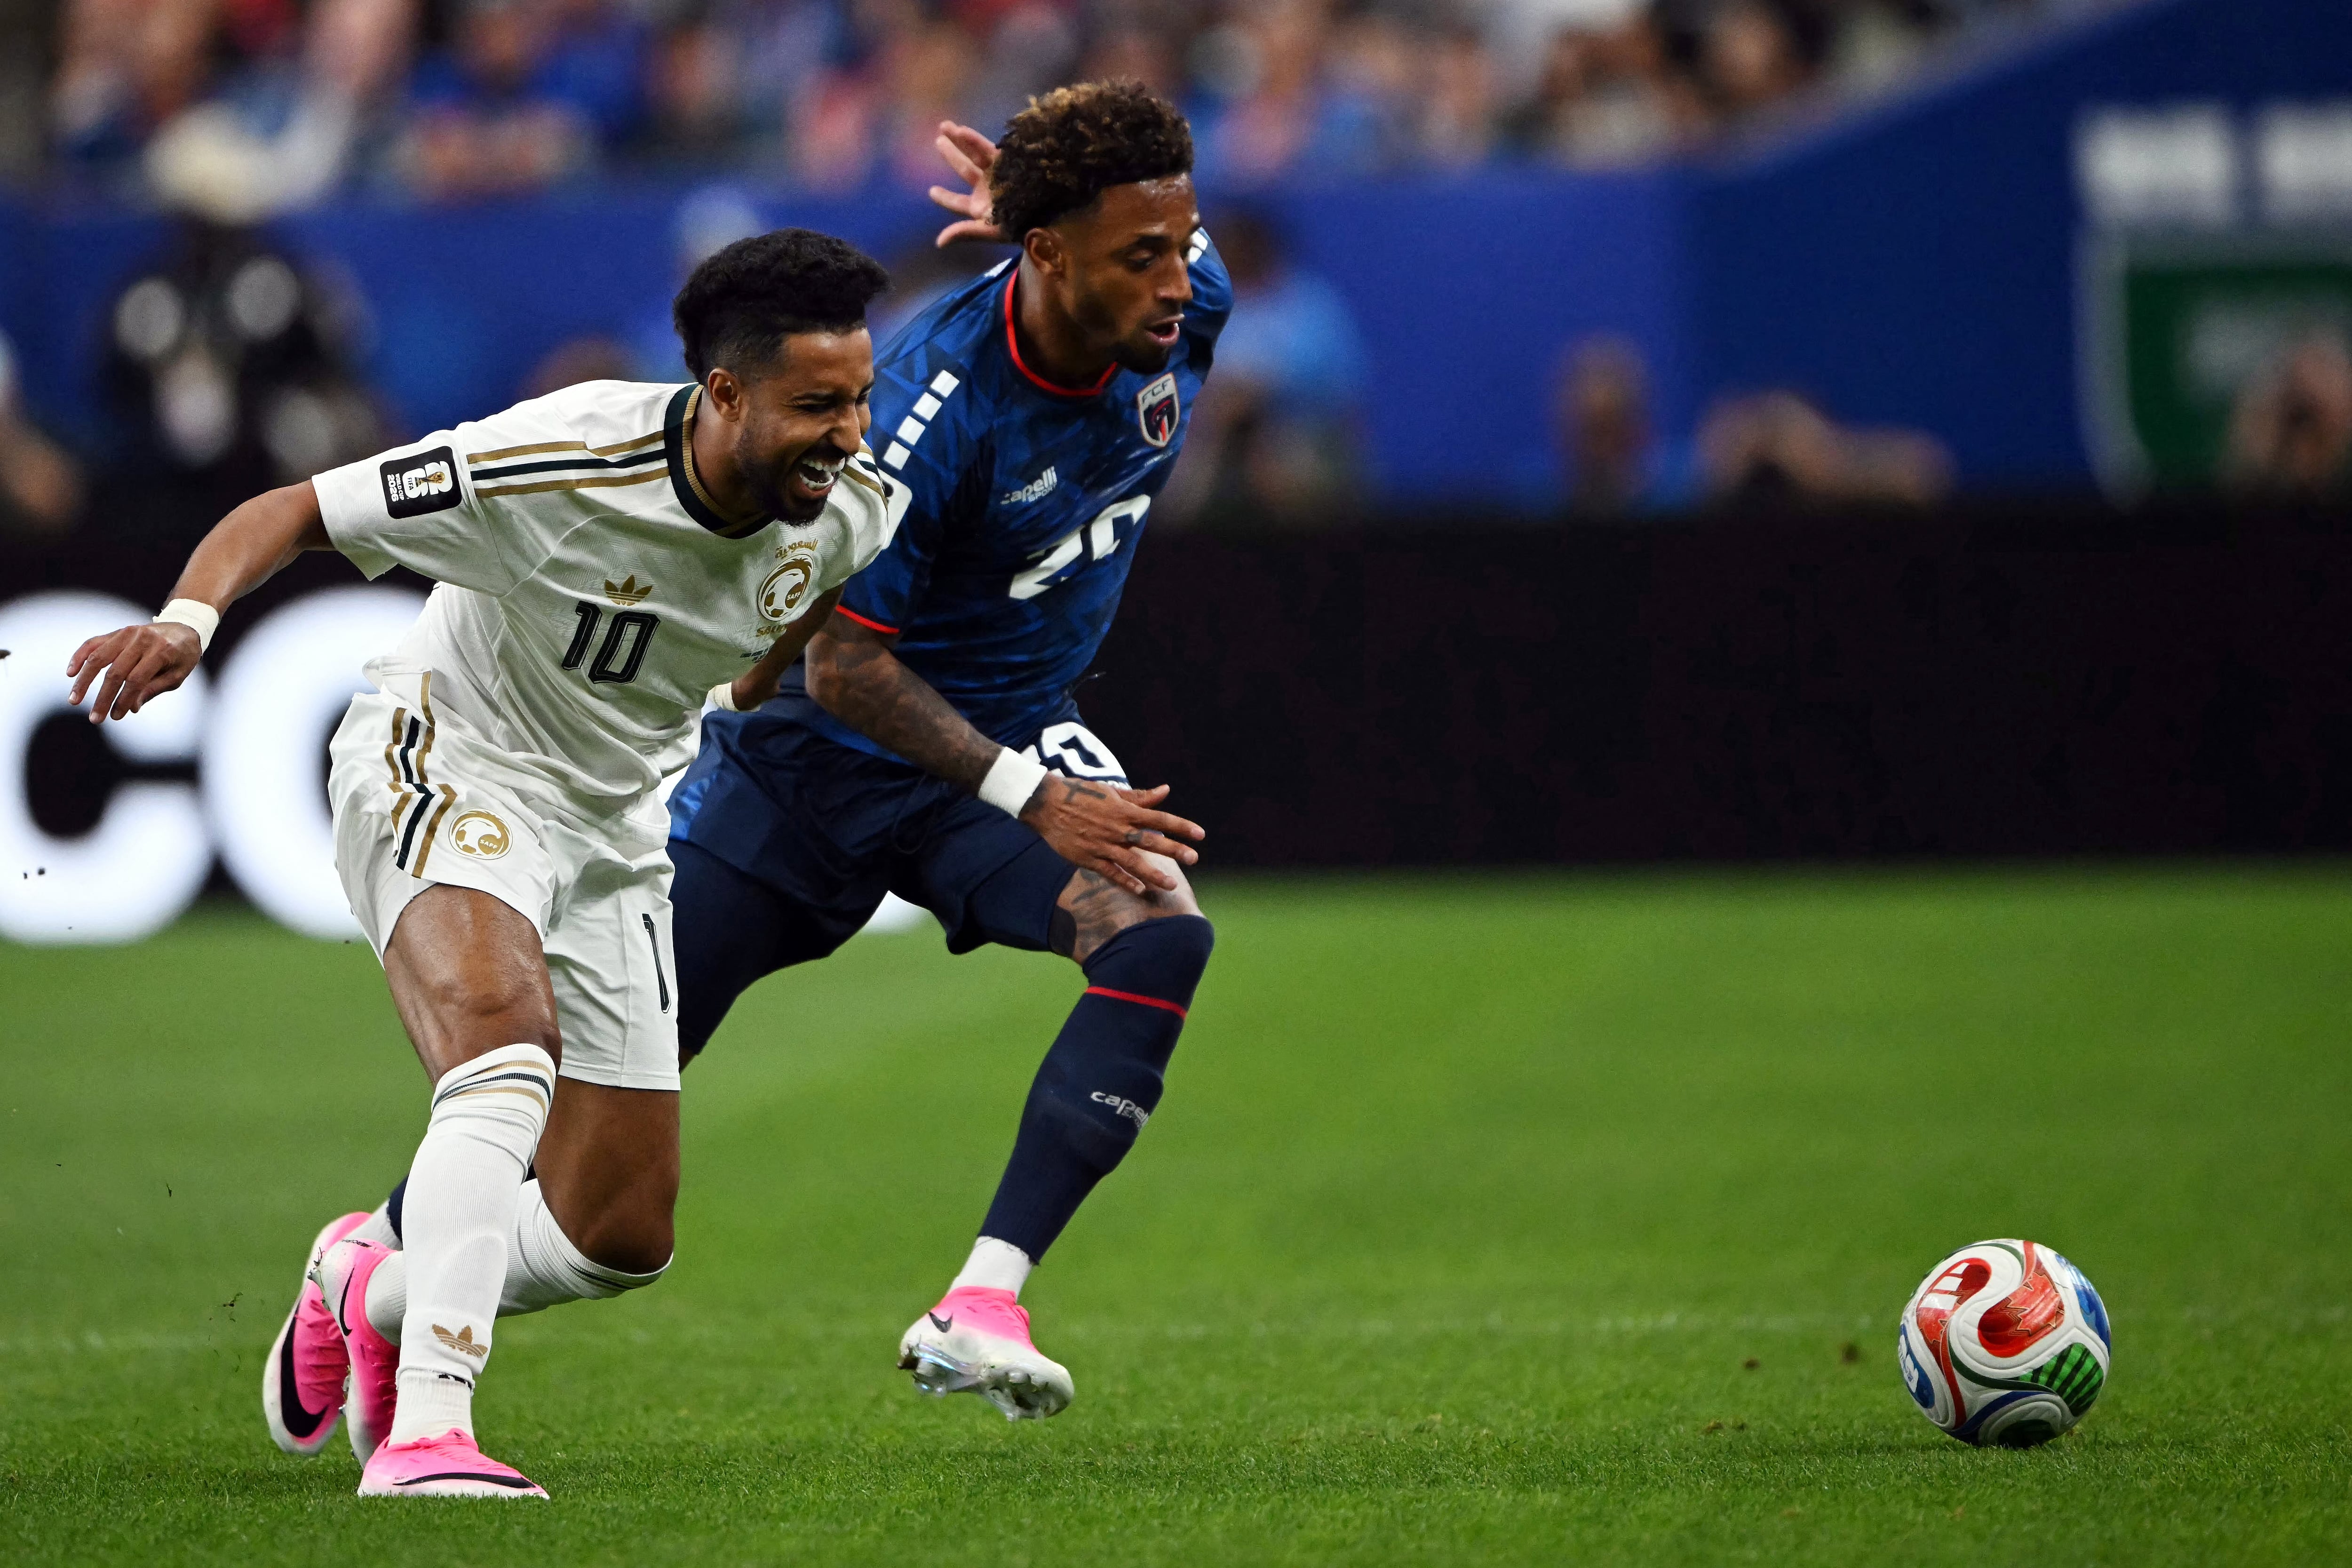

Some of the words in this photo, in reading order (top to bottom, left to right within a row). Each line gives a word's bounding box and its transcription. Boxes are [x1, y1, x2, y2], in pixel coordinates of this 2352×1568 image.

[1142, 378, 1171, 404] FCF
[387, 474, 399, 502] 2026
[787, 591, 801, 600] SAFF
[561, 600, 660, 685] 10
[479, 839, 498, 850] SAFF
